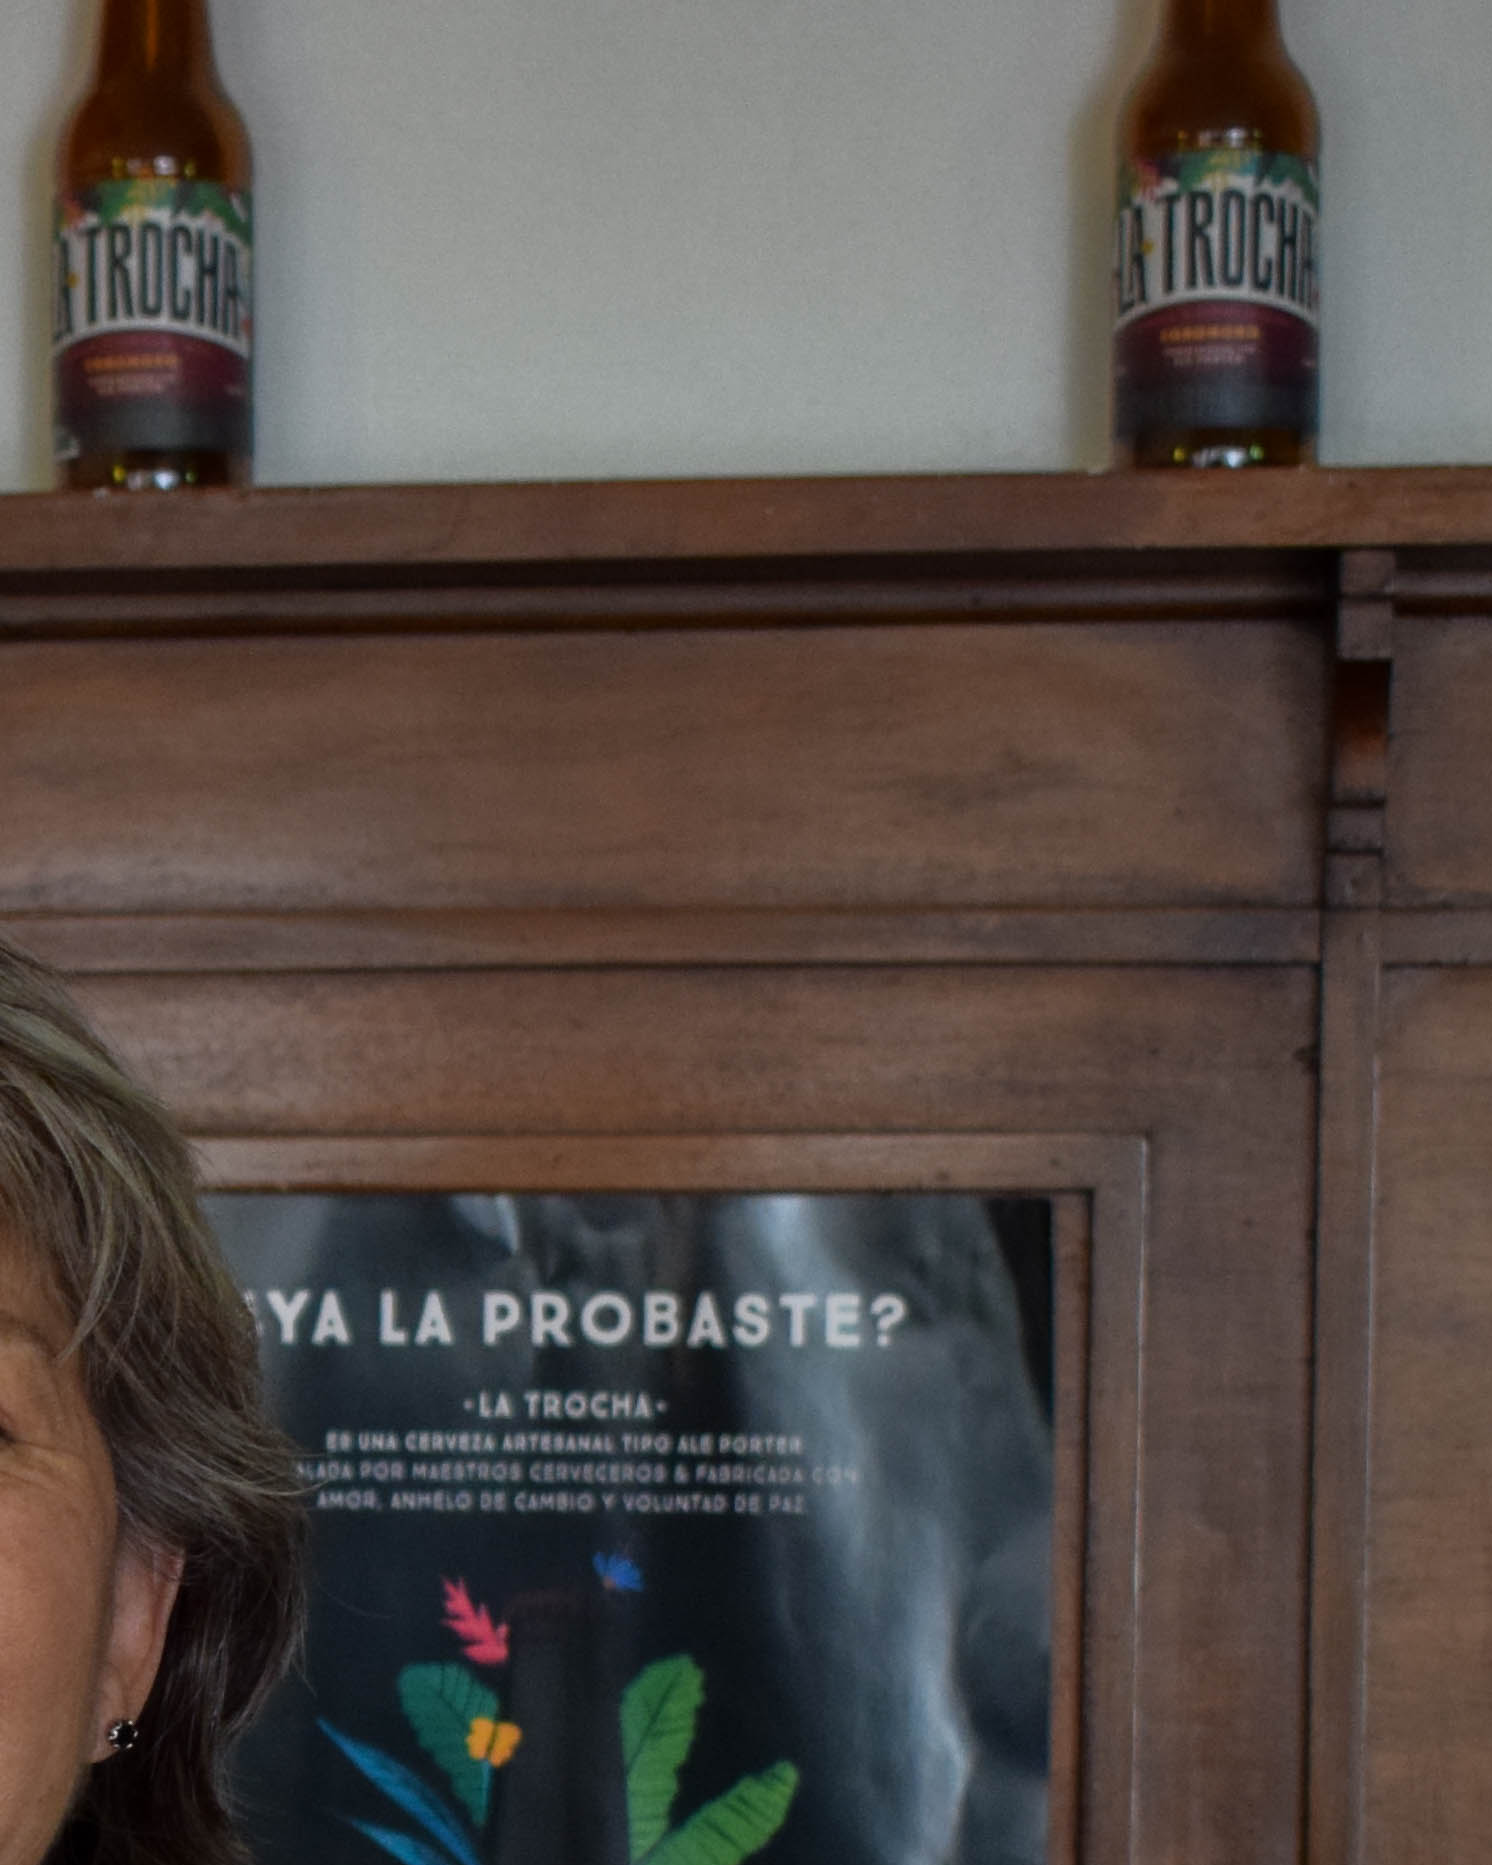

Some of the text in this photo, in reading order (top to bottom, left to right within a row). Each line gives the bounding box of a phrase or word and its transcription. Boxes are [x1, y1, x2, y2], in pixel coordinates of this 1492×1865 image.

[82, 222, 241, 337] TROCHA
[378, 1288, 454, 1347] LA
[482, 1288, 908, 1350] PROBASTE?
[358, 1430, 398, 1452] UNA
[404, 1430, 496, 1453] CERVEZA
[501, 1431, 614, 1454] ARTESANAL
[621, 1432, 667, 1454] TIPO
[677, 1433, 715, 1454] ALE
[718, 1434, 803, 1456] PORTER
[360, 1461, 407, 1482] POR
[412, 1461, 523, 1483] MAESTROS
[528, 1462, 667, 1483] CERVECEROS
[694, 1462, 804, 1484] FABRICADA
[390, 1490, 472, 1512] ANHELO
[479, 1490, 508, 1512] DE
[513, 1491, 596, 1513] CAMBIO
[622, 1492, 730, 1514] VOLUNTAD
[734, 1493, 762, 1514] DE
[767, 1494, 806, 1515] PAZ
